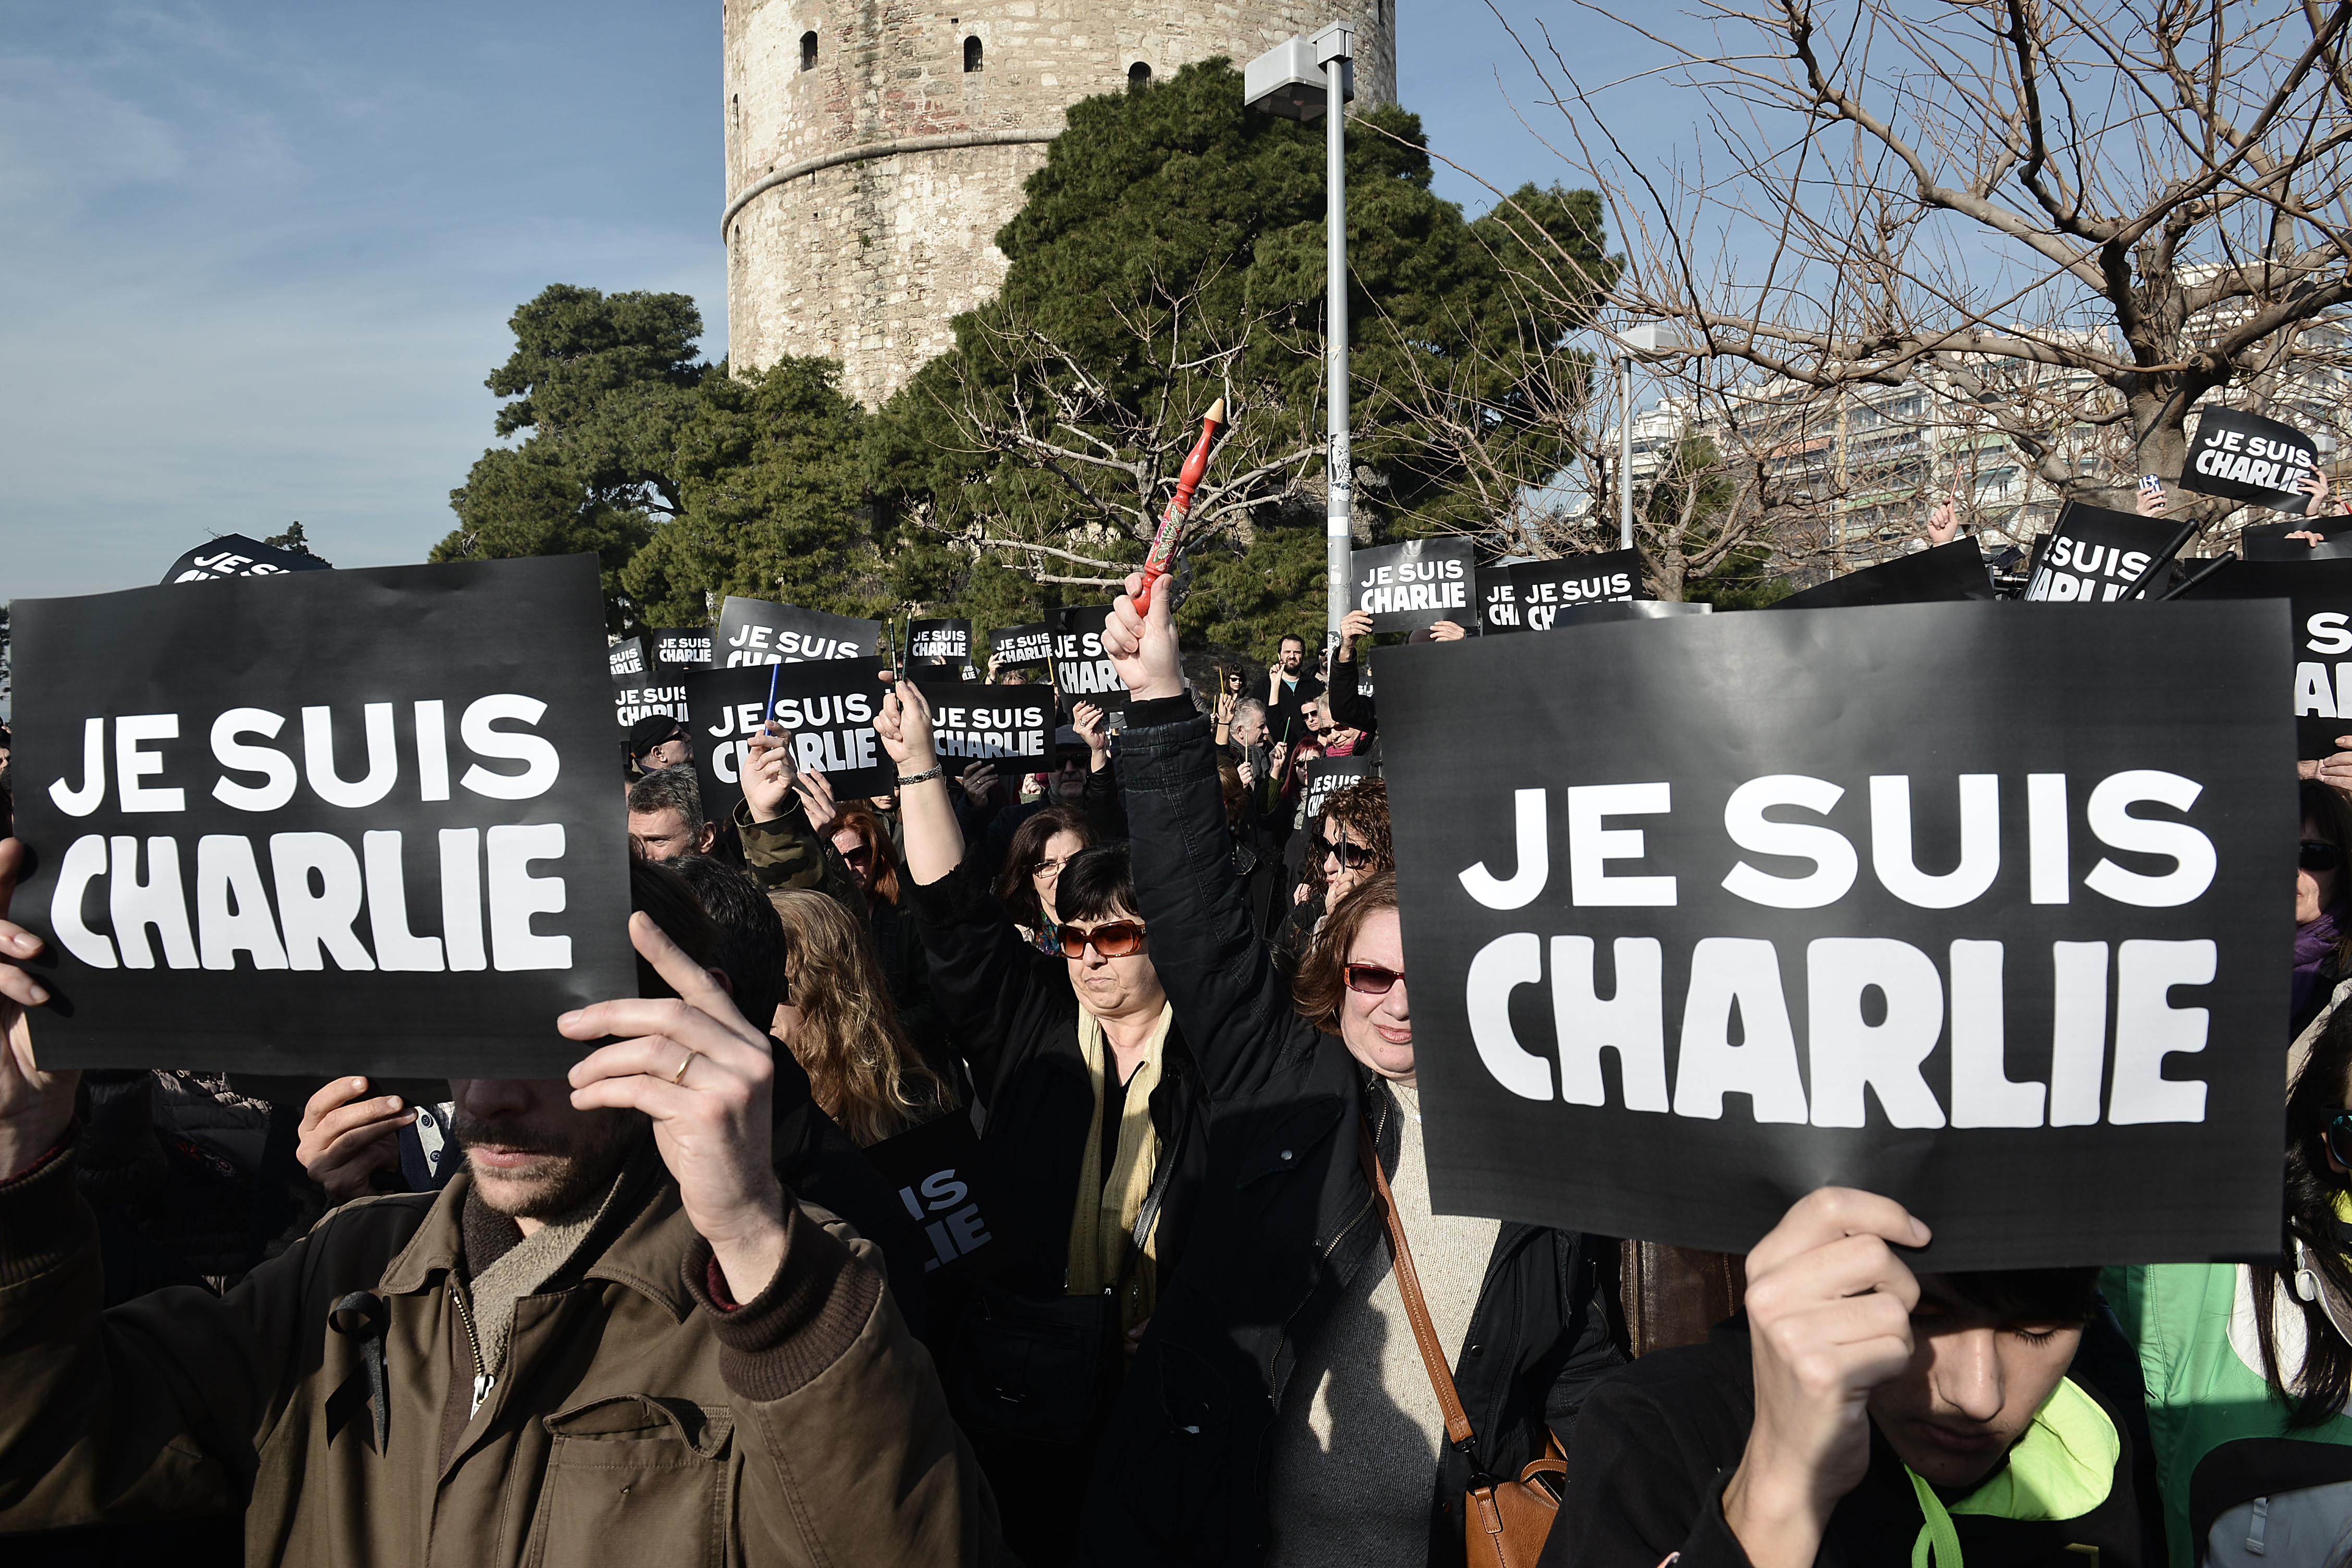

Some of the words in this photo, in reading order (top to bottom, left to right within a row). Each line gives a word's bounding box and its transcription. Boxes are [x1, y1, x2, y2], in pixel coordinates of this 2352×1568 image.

[2204, 430, 2245, 452] JE
[2246, 437, 2312, 467] SUIS
[2196, 449, 2310, 495] CHARLIE
[194, 552, 254, 574] JE
[1361, 565, 1393, 587] JE
[1398, 559, 1464, 582] SUIS
[2051, 536, 2151, 582] SUIS
[1361, 582, 1466, 614] CHARLIE
[1487, 585, 1515, 603] JE
[1525, 583, 1558, 604] JE
[1562, 573, 1631, 601] SUIS
[658, 639, 677, 648] JE
[679, 638, 712, 648] SUIS
[728, 624, 773, 649] JE
[775, 631, 860, 660] SUIS
[912, 642, 966, 657] CHARLIE
[913, 631, 930, 642] JE
[932, 631, 966, 641] SUIS
[997, 638, 1015, 652] JE
[1017, 632, 1050, 647] SUIS
[1055, 634, 1079, 658] JE
[1082, 632, 1109, 657] S
[609, 648, 638, 665] SUIS
[659, 649, 712, 662] CHARLIE
[998, 644, 1053, 664] CHARLIE
[1058, 659, 1130, 694] CHAR
[615, 689, 640, 705] JE
[708, 703, 766, 737] JE
[775, 694, 872, 729] SUIS
[932, 707, 966, 728] JE
[972, 707, 1043, 729] SUIS
[48, 714, 186, 817] JE
[211, 694, 560, 812] SUIS
[712, 728, 877, 783] CRLIE
[933, 729, 1044, 759] CHARLIE
[1310, 776, 1323, 793] JE
[1459, 782, 1677, 910] JE
[1721, 769, 2217, 909] SUIS
[51, 823, 572, 972] CHARLIE
[1466, 933, 2217, 1129] CHARLIE
[924, 1203, 993, 1273] IE
